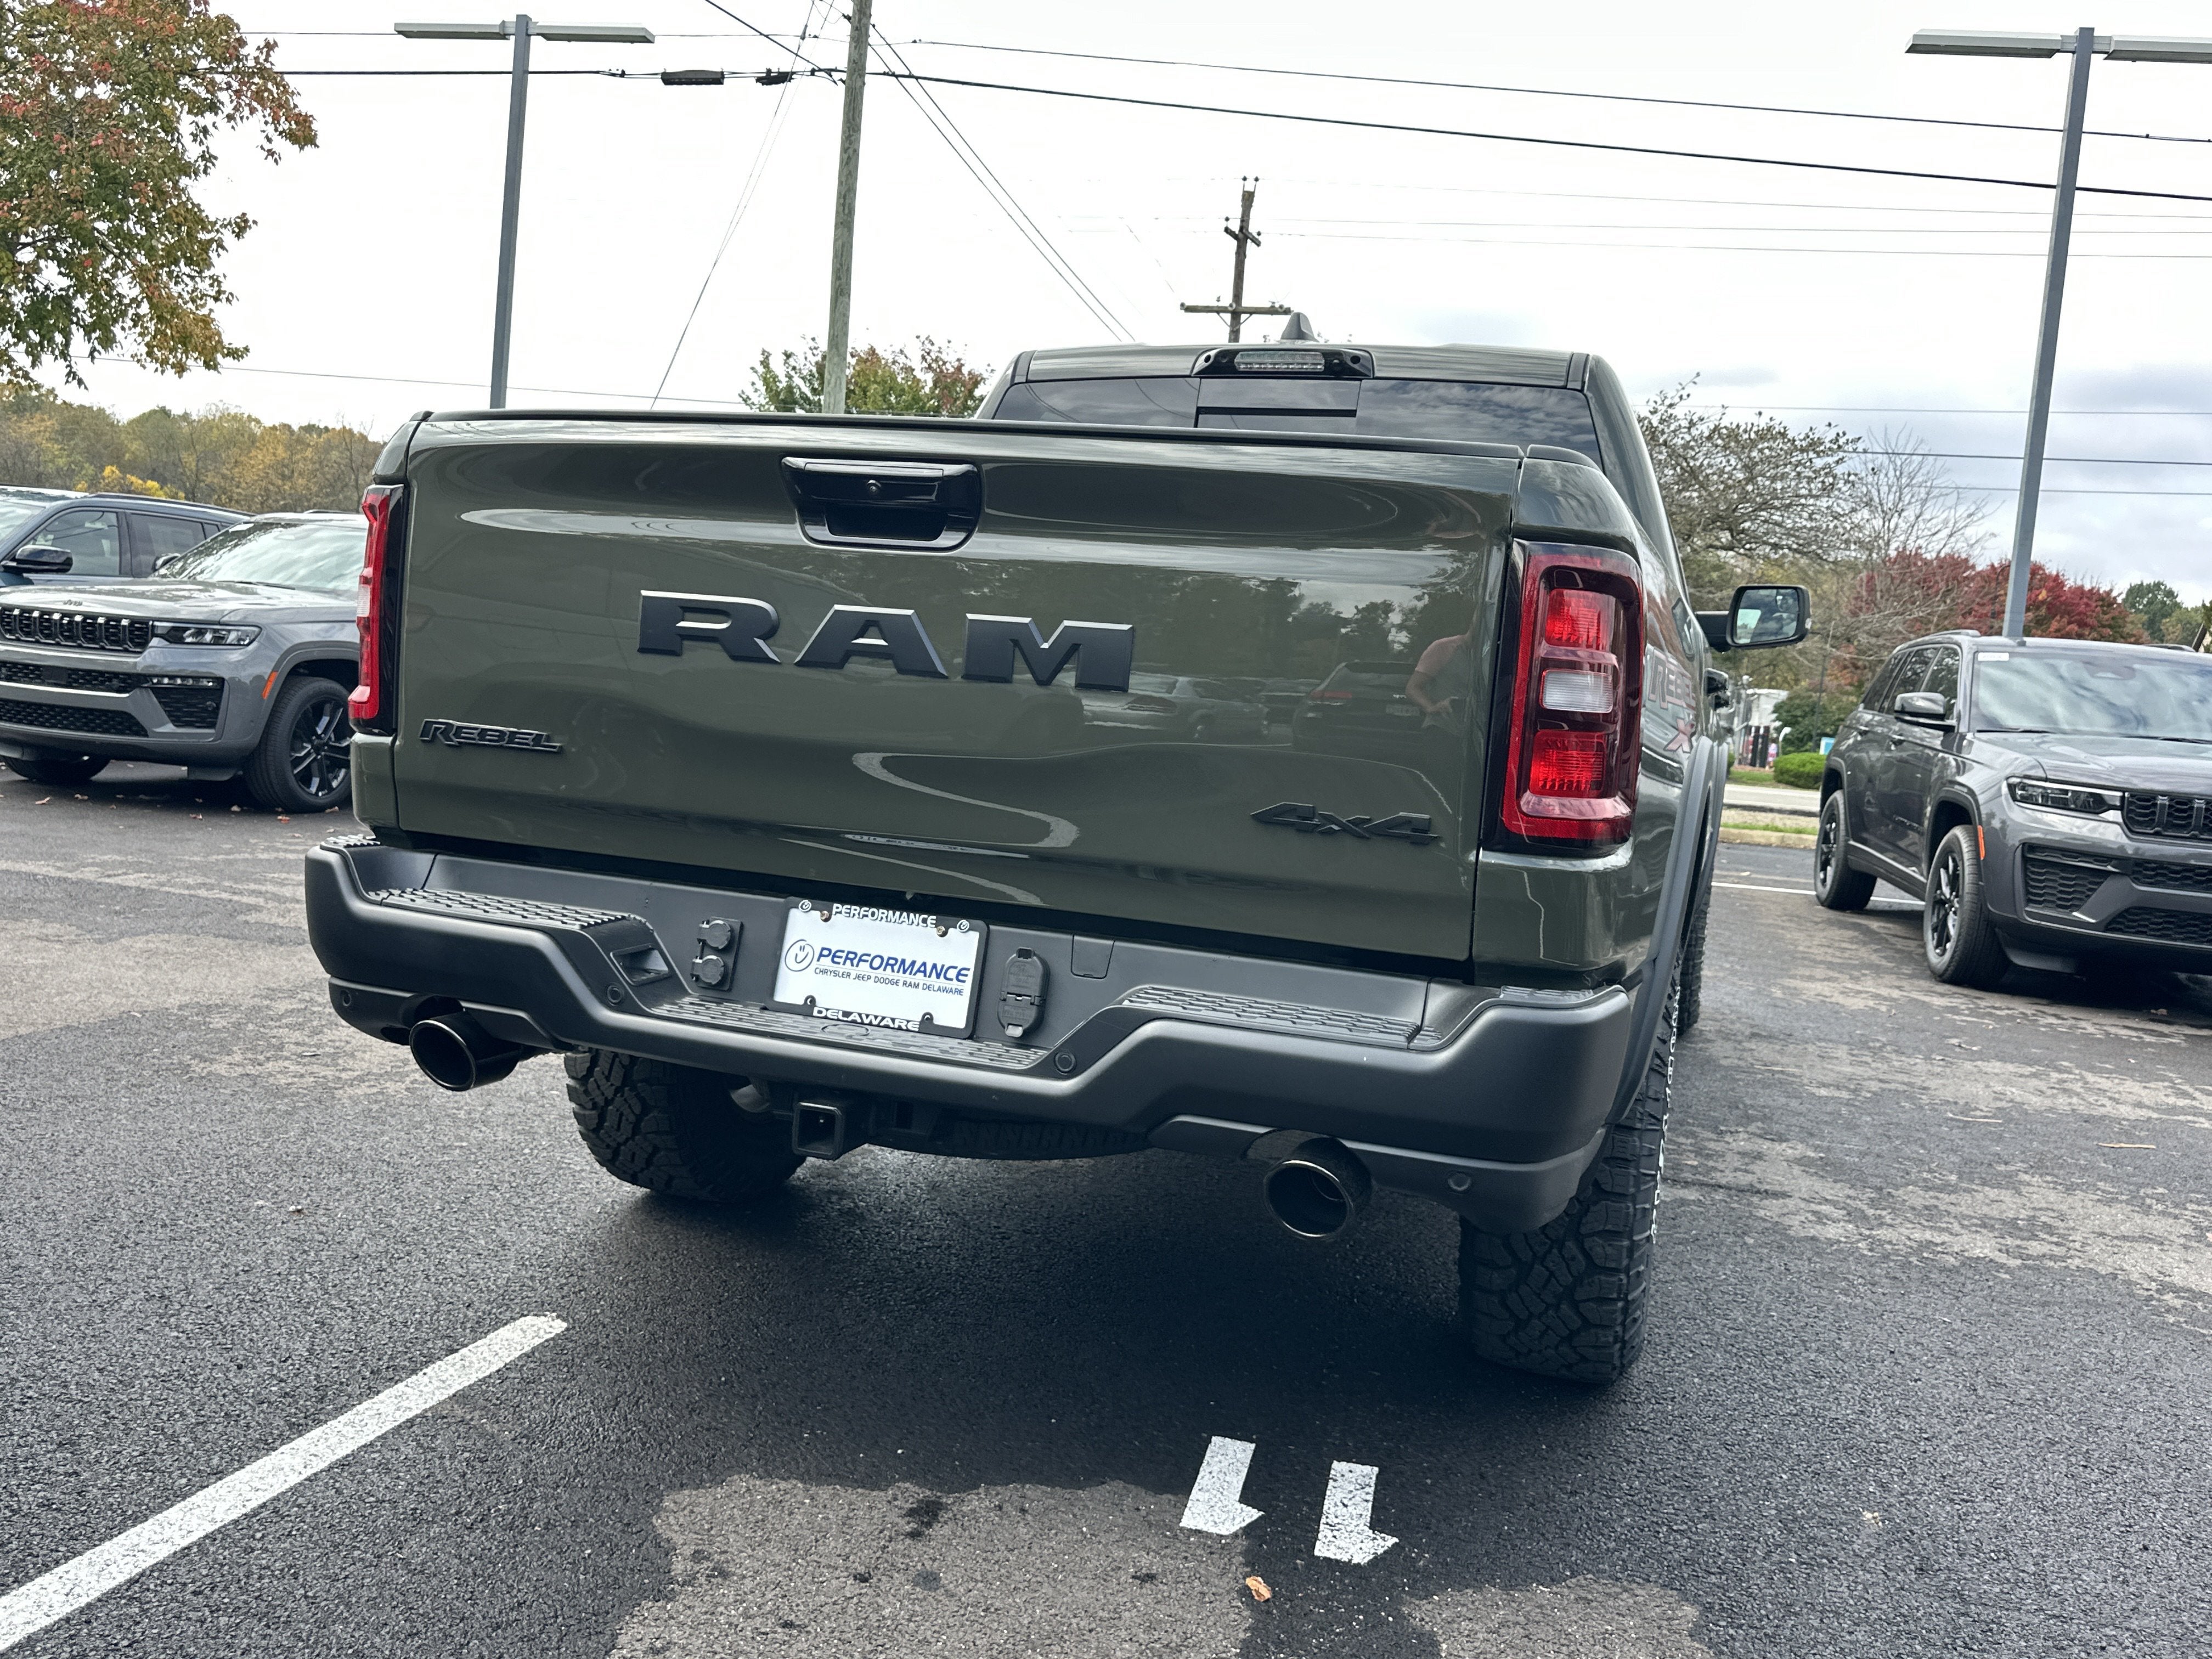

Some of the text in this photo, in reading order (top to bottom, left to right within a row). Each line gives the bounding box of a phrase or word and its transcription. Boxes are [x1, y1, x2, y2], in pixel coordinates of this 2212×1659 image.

[636, 589, 1135, 692] RAM
[419, 718, 563, 753] REBEL
[832, 904, 936, 928] PERFORMANCE
[816, 947, 970, 983] PERFORMANCE
[814, 967, 964, 996] CHRYSLER JEEP DODGE RAM DELAWARE
[812, 1007, 920, 1031] DELAWARE
